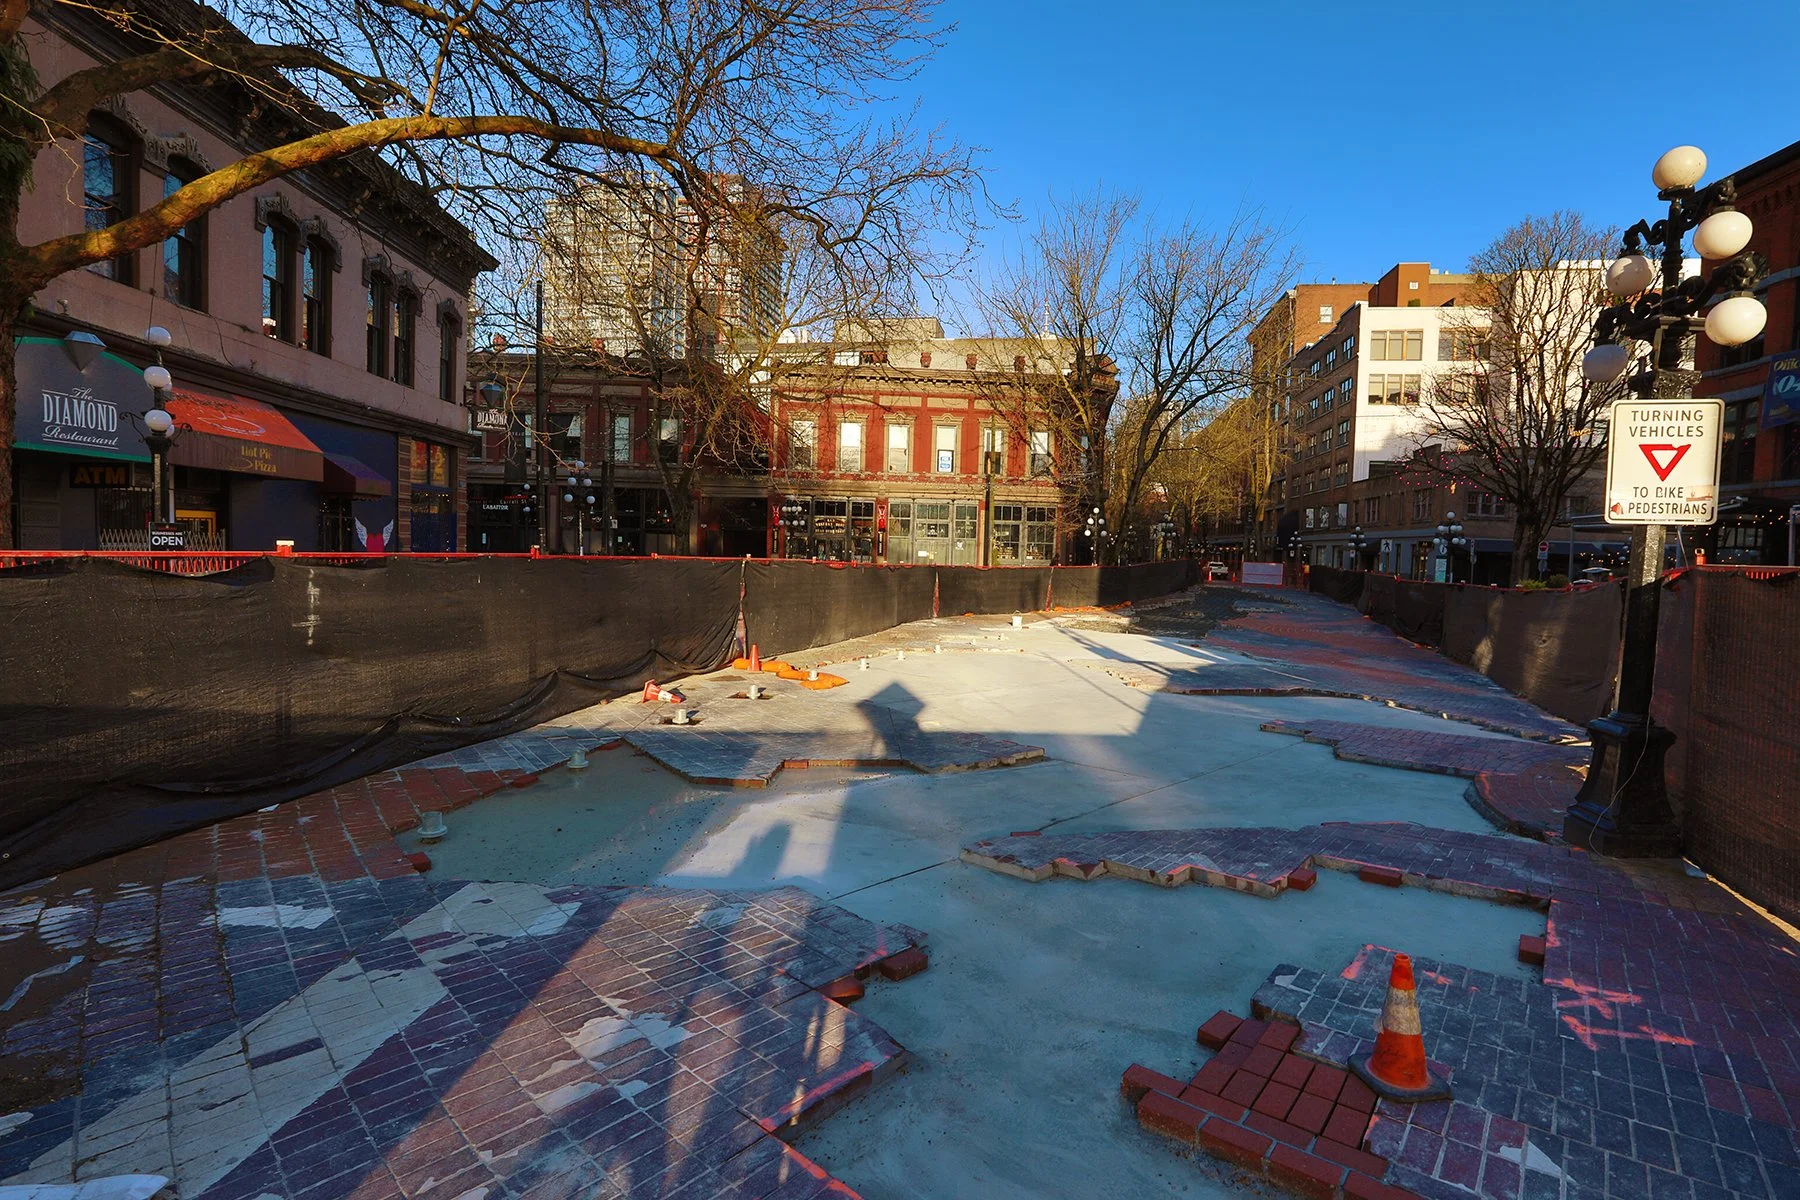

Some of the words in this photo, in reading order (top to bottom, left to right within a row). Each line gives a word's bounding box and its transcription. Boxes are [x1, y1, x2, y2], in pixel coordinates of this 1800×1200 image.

[71, 387, 93, 401] The
[42, 393, 118, 432] DIAMOND
[1631, 410, 1704, 421] TURNING
[42, 425, 119, 446] Restaurant
[1629, 426, 1704, 437] VEHICLES
[241, 446, 257, 458] Hot
[254, 460, 277, 473] Pizza
[74, 467, 125, 485] ATM
[1633, 487, 1649, 498] TO
[1656, 486, 1684, 499] BIKE
[1628, 502, 1708, 515] PEDESTRIANS
[151, 536, 183, 546] OPEN
